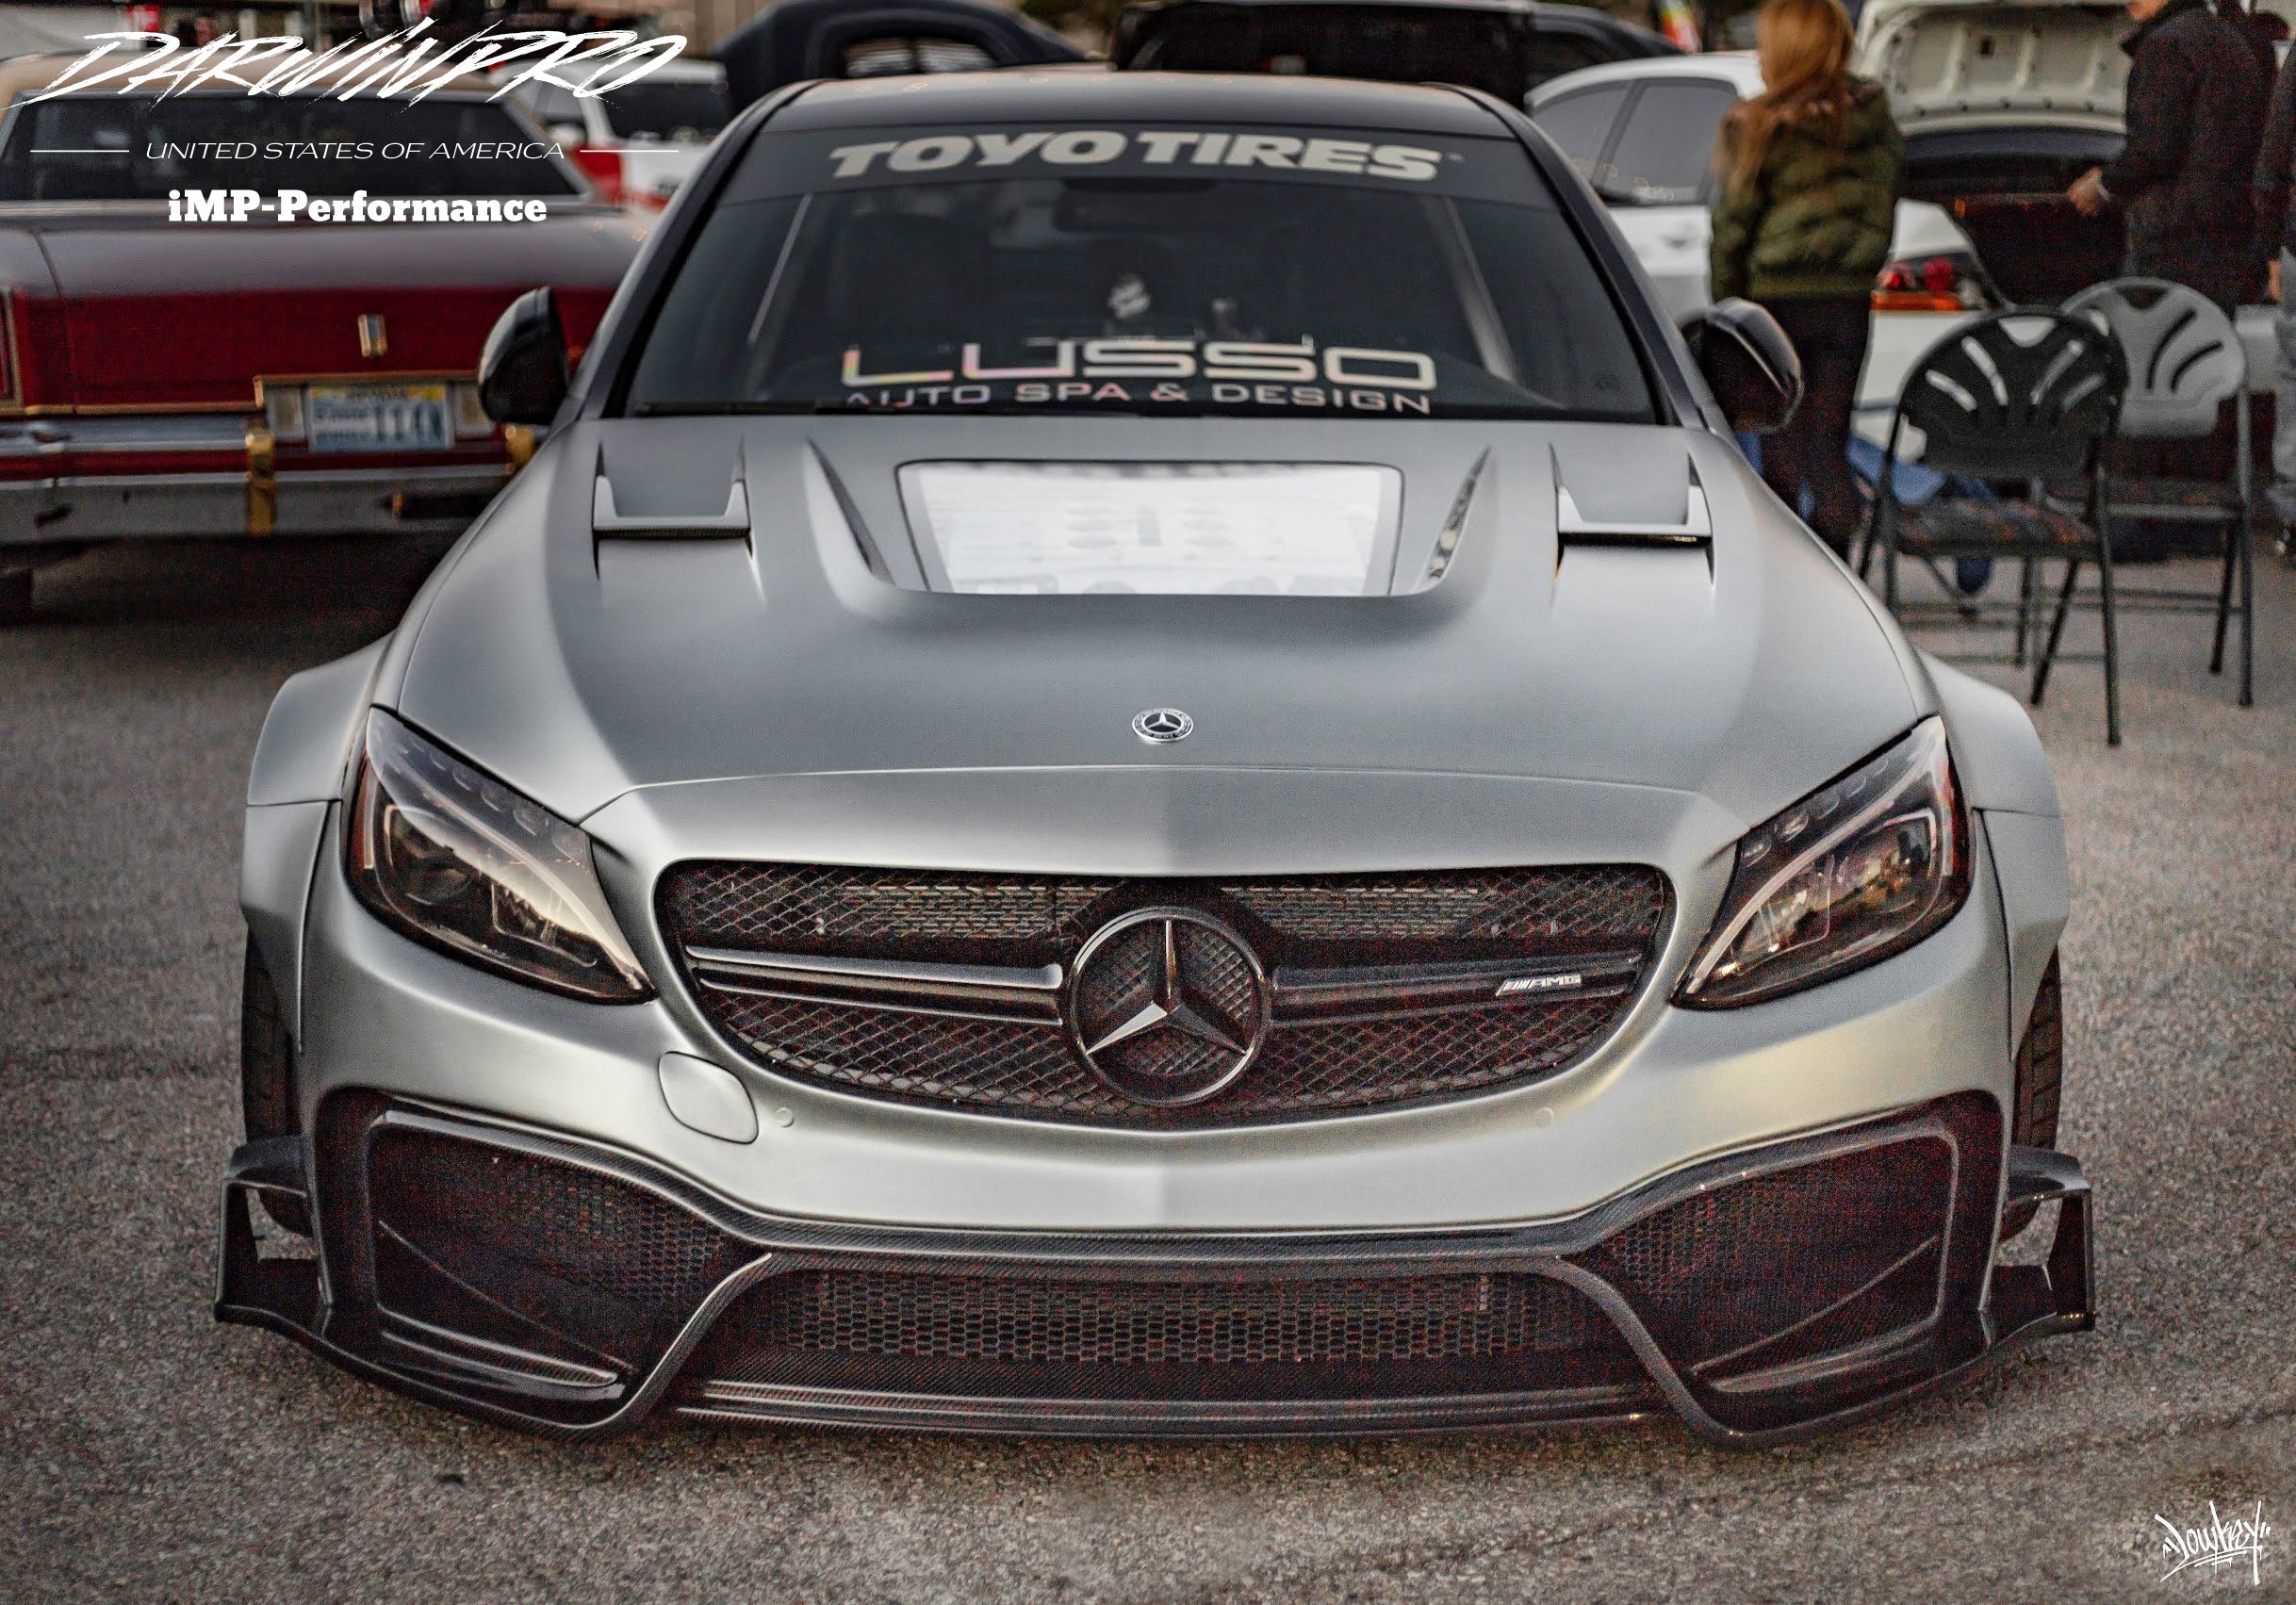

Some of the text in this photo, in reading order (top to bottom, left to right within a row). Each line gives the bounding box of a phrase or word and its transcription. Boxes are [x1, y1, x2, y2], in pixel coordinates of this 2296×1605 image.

[828, 130, 1443, 182] TOYO TIRES
[842, 338, 1437, 391] LUSSO
[846, 382, 1431, 415] AUTO SPA & DESIGN
